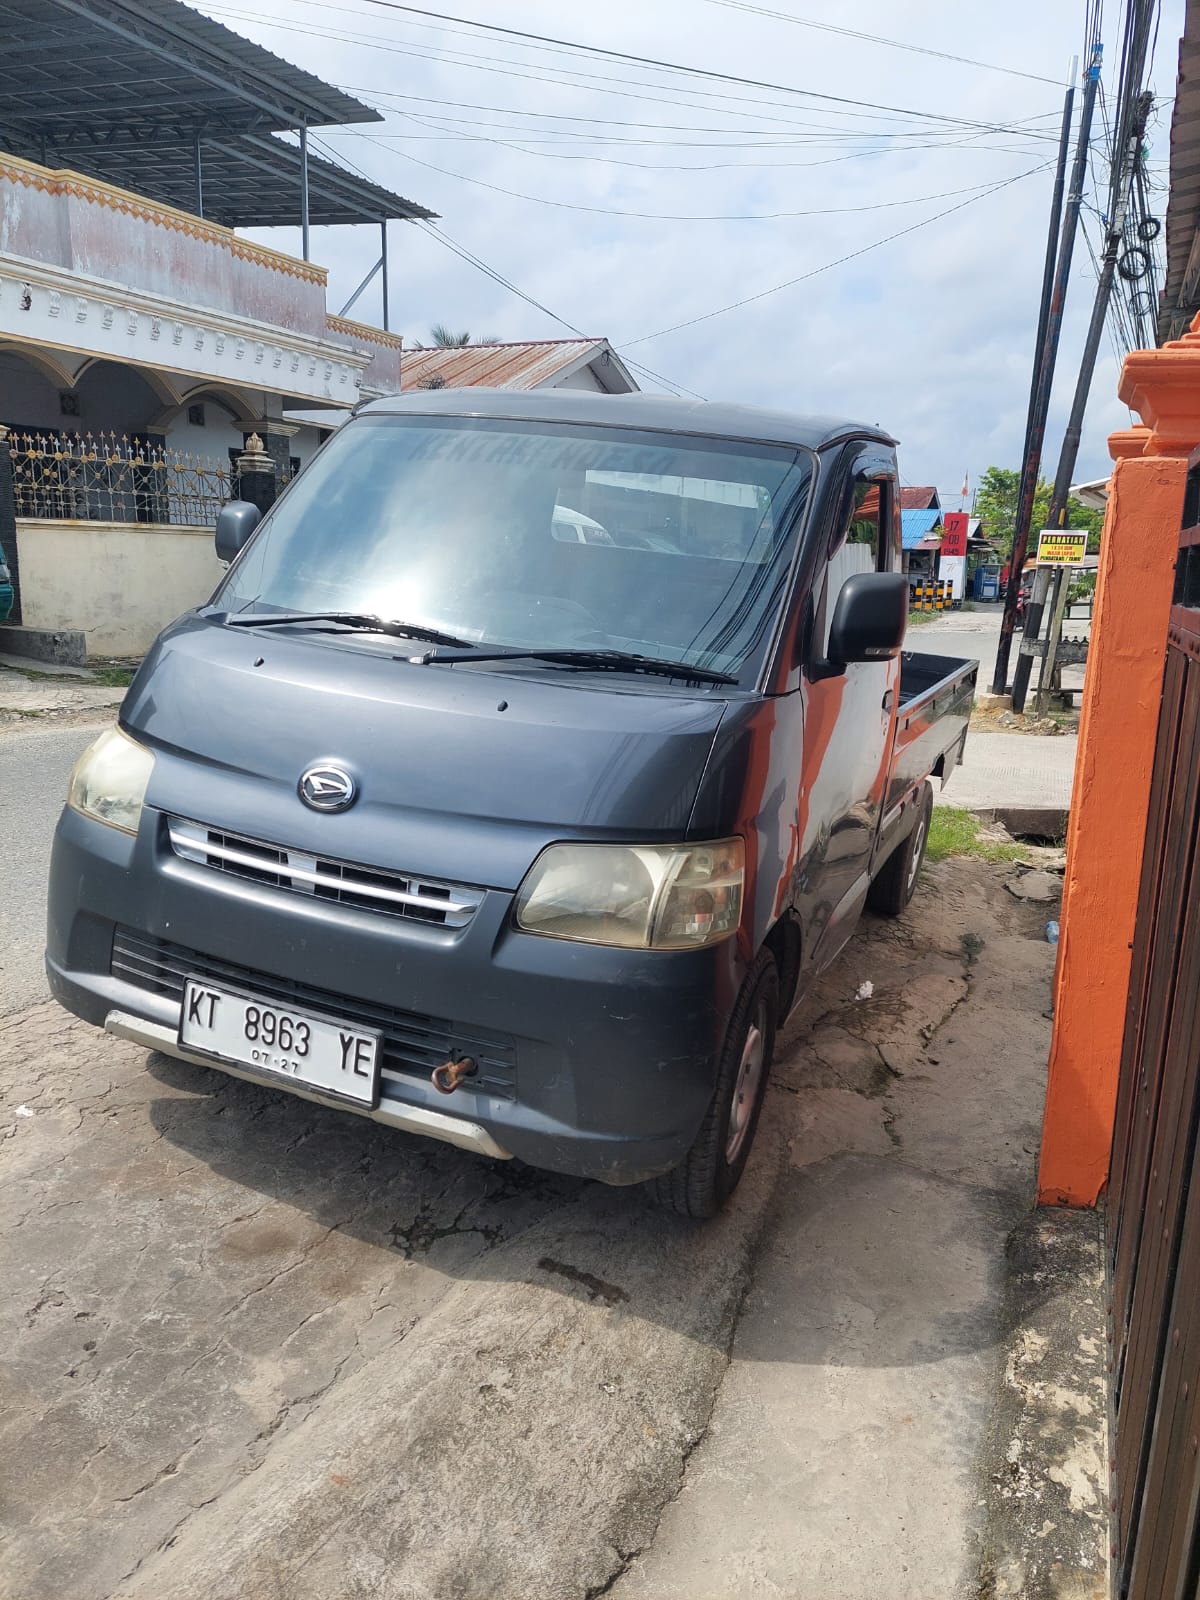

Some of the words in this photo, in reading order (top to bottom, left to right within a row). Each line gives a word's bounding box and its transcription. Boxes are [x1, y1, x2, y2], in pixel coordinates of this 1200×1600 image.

[950, 520, 960, 531] 17
[1043, 535, 1084, 544] PERHATIAN
[188, 987, 221, 1029] KT
[245, 1006, 311, 1057] 8963
[339, 1031, 373, 1078] YE
